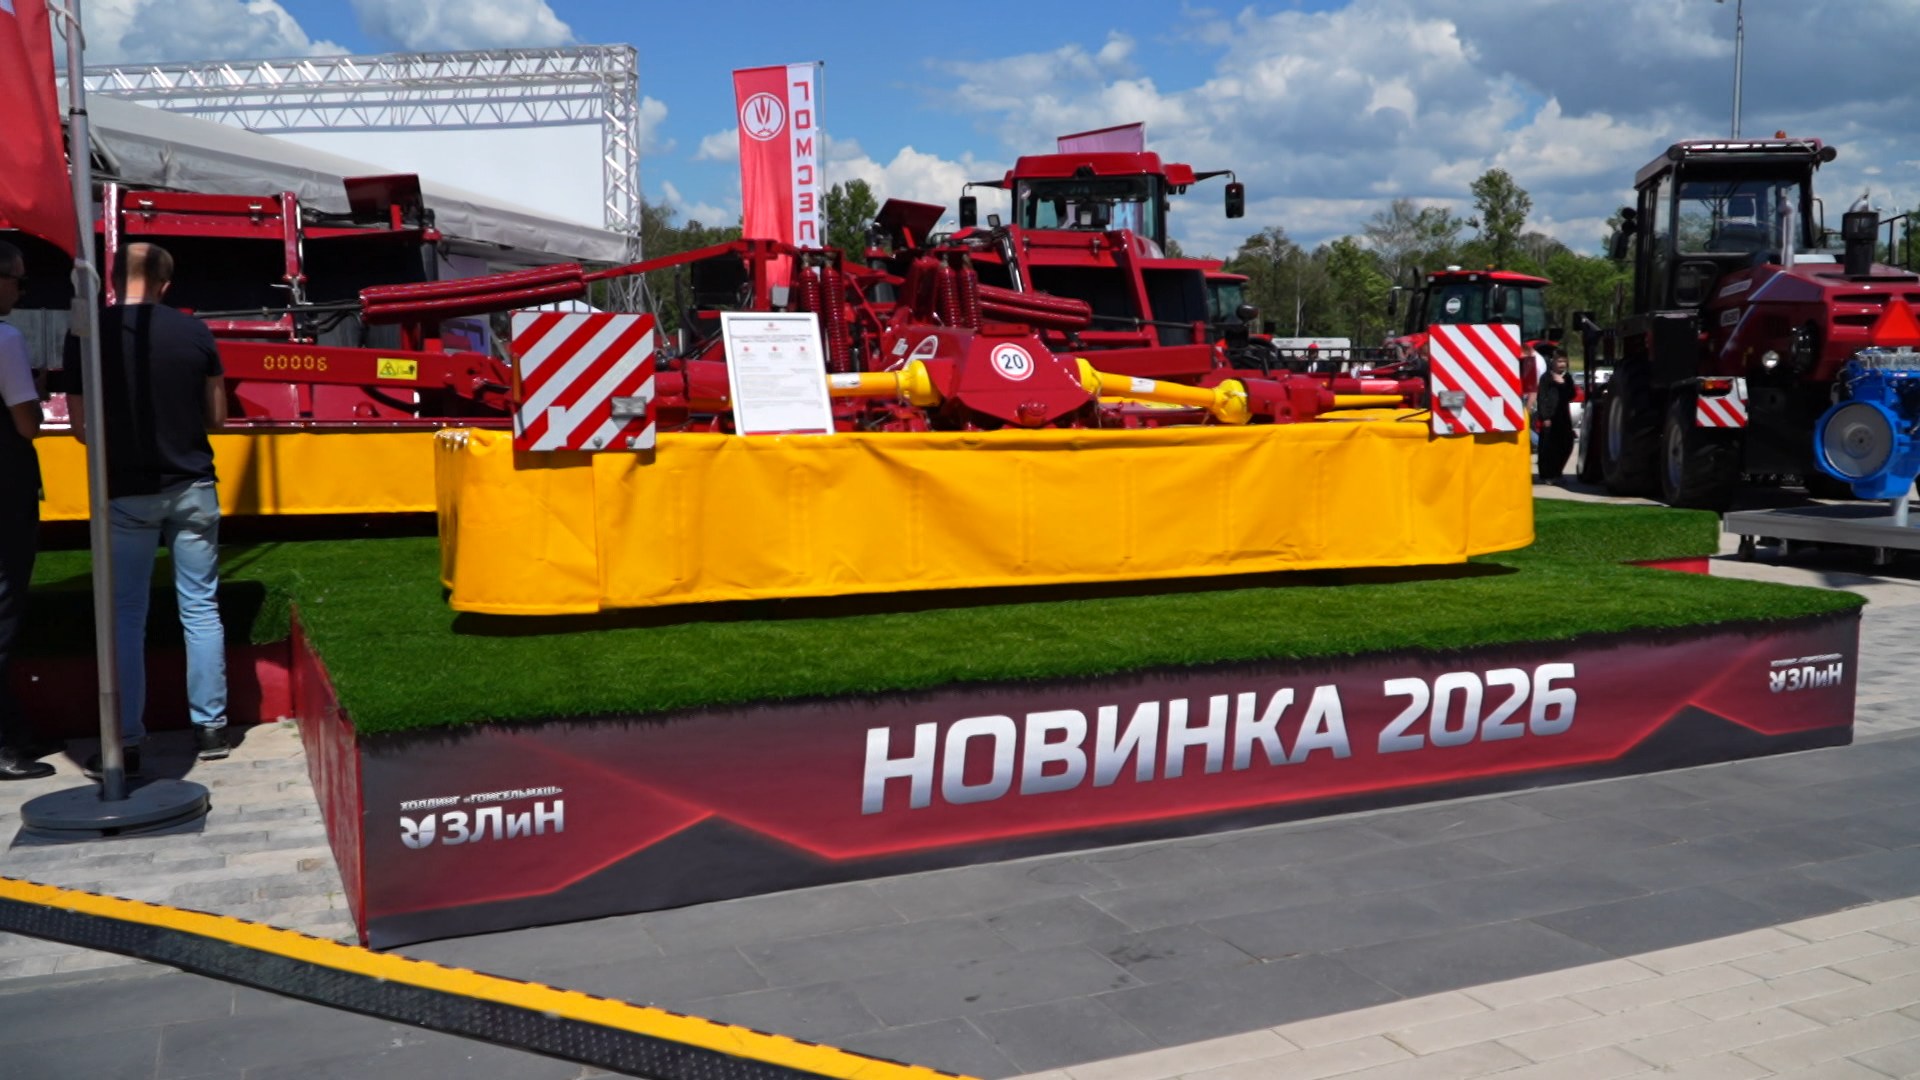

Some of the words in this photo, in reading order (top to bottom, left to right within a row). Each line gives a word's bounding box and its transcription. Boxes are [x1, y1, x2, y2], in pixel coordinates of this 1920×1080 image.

[264, 355, 327, 371] 00006
[1001, 354, 1024, 369] 20
[861, 684, 1352, 815] НОВИНКА
[1377, 663, 1577, 754] 2026
